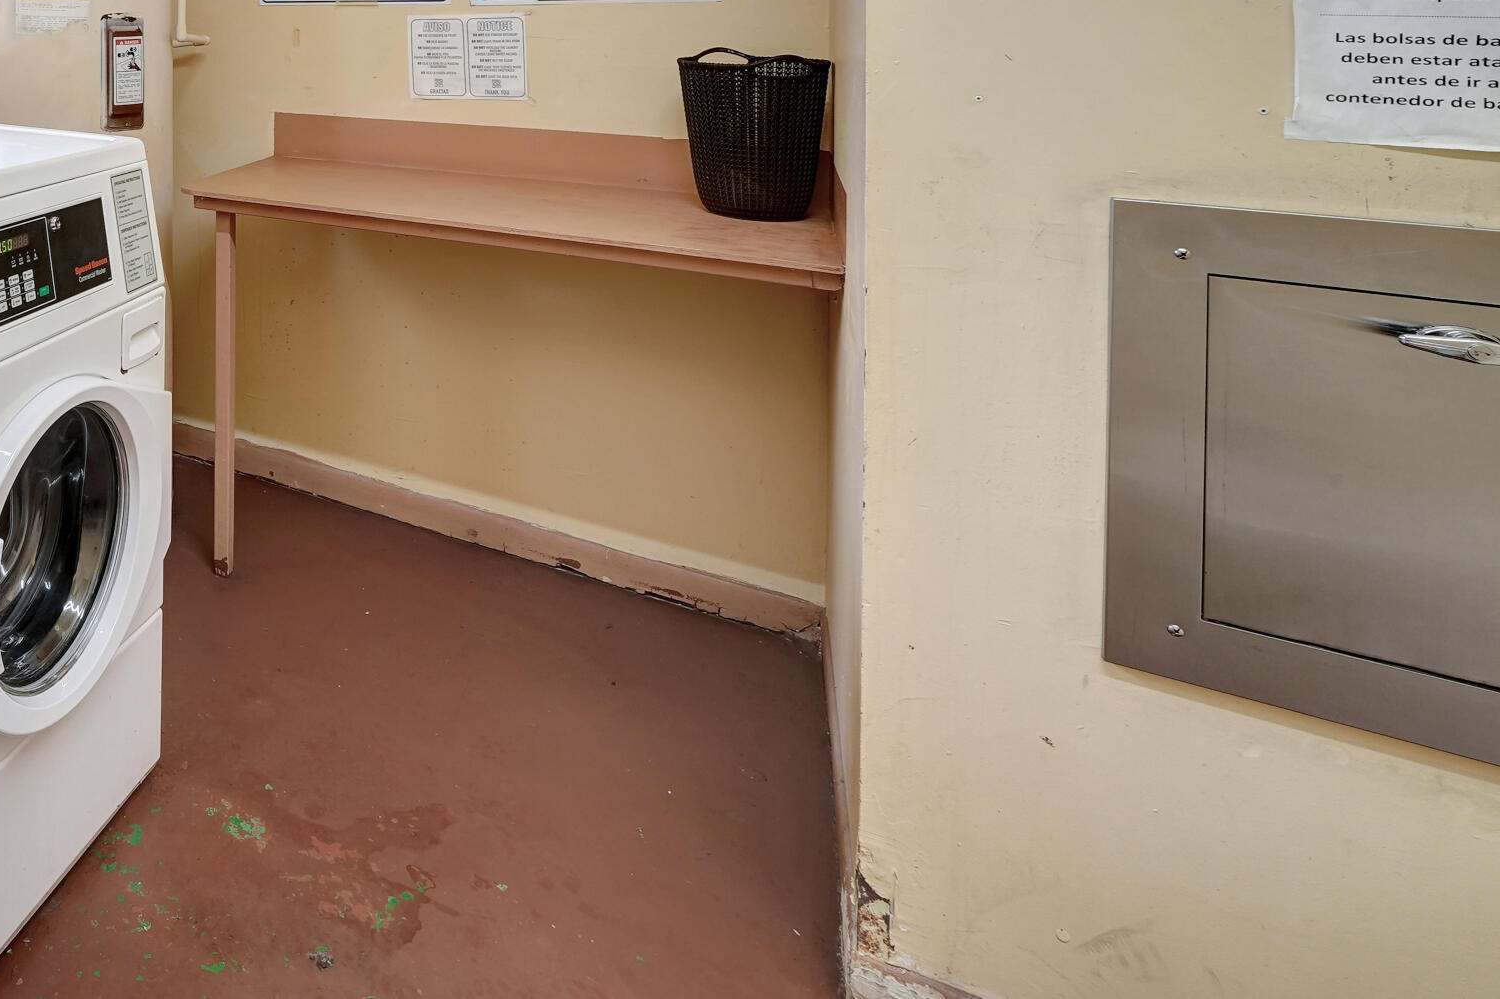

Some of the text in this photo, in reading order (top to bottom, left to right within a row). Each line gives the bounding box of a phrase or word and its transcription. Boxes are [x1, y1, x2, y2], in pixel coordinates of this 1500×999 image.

[423, 22, 450, 32] AVISO
[477, 20, 513, 31] NOTICE
[1336, 32, 1366, 43] Las
[1373, 32, 1436, 44] bolsas
[1443, 34, 1468, 45] de
[1341, 52, 1403, 64] deben
[1411, 56, 1462, 66] estar
[1372, 75, 1481, 87] antes de ir
[1326, 94, 1476, 108] contenedor de
[75, 258, 108, 275] Speed Queen
